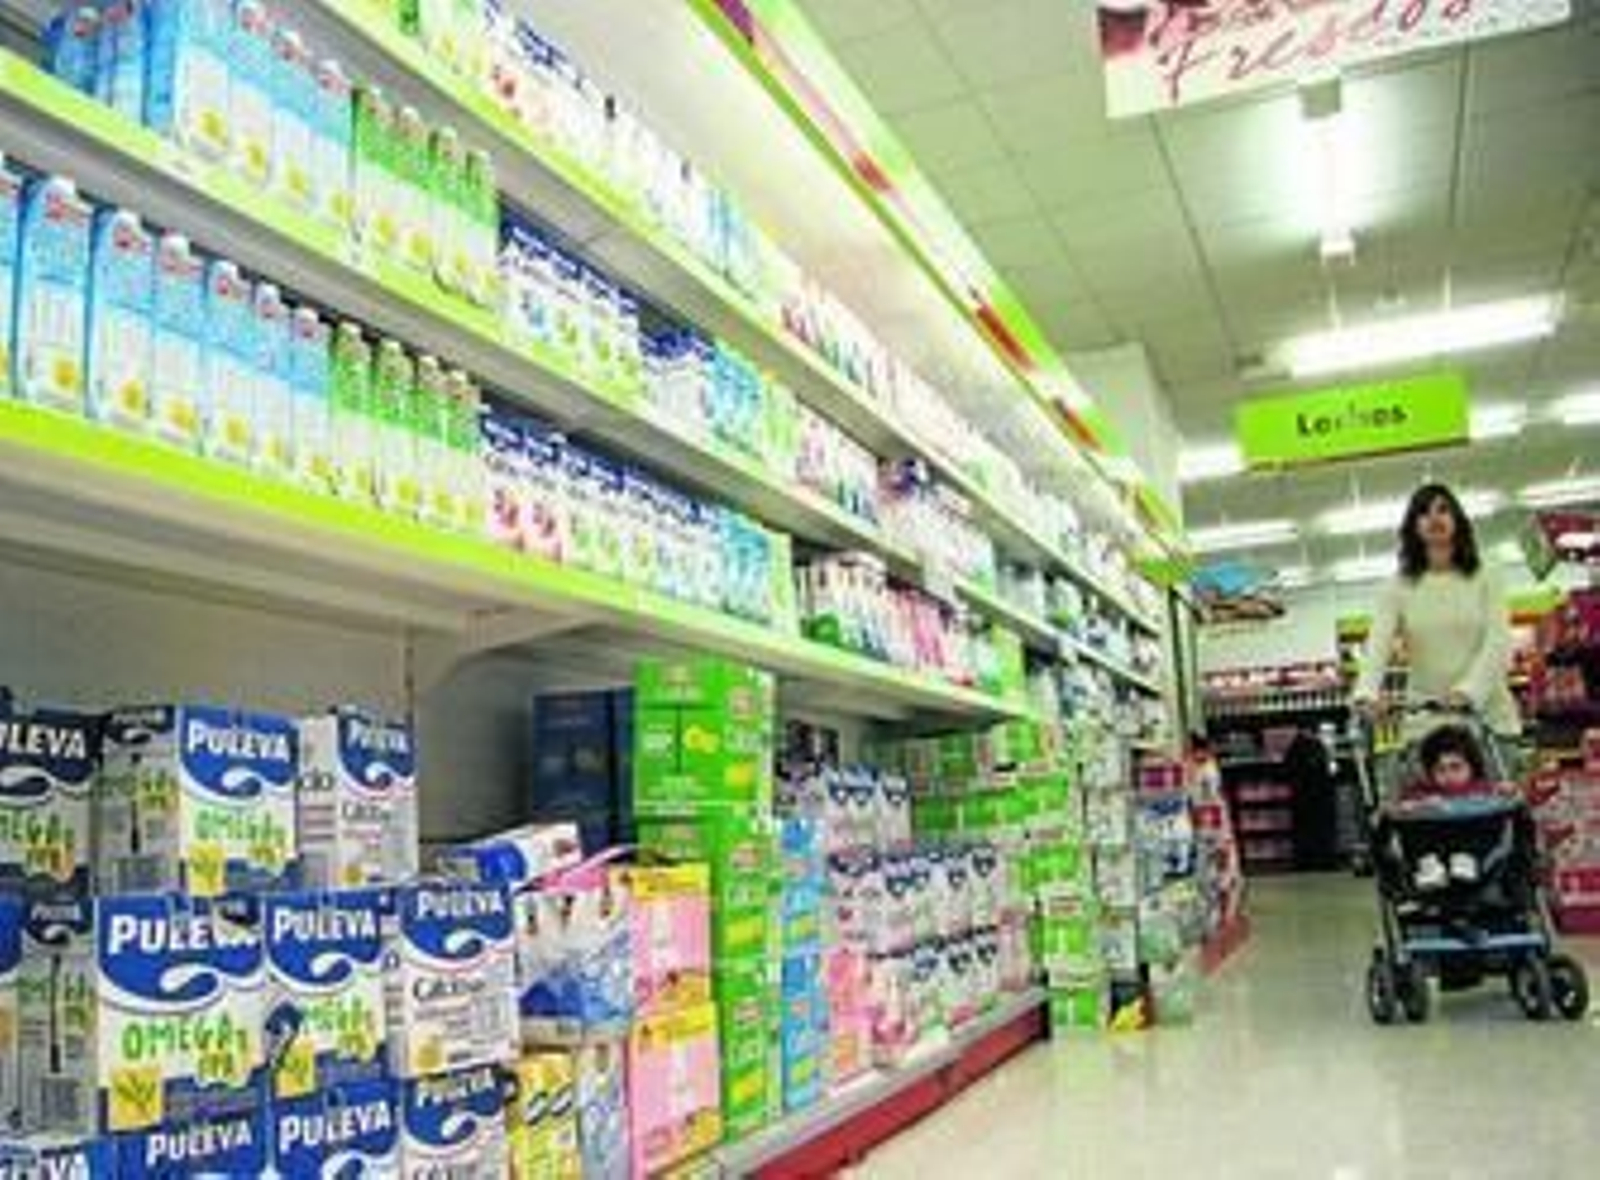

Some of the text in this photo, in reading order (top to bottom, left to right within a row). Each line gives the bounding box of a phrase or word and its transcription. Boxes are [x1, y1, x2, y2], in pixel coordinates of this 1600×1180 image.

[187, 718, 291, 764] PULEVA
[273, 907, 377, 943] PULEVA
[417, 889, 505, 918] PULEVA
[107, 914, 258, 955] PULE
[121, 1010, 234, 1063] OMEGA
[146, 1119, 253, 1166] PULEVA
[274, 1099, 393, 1156] PULEVA
